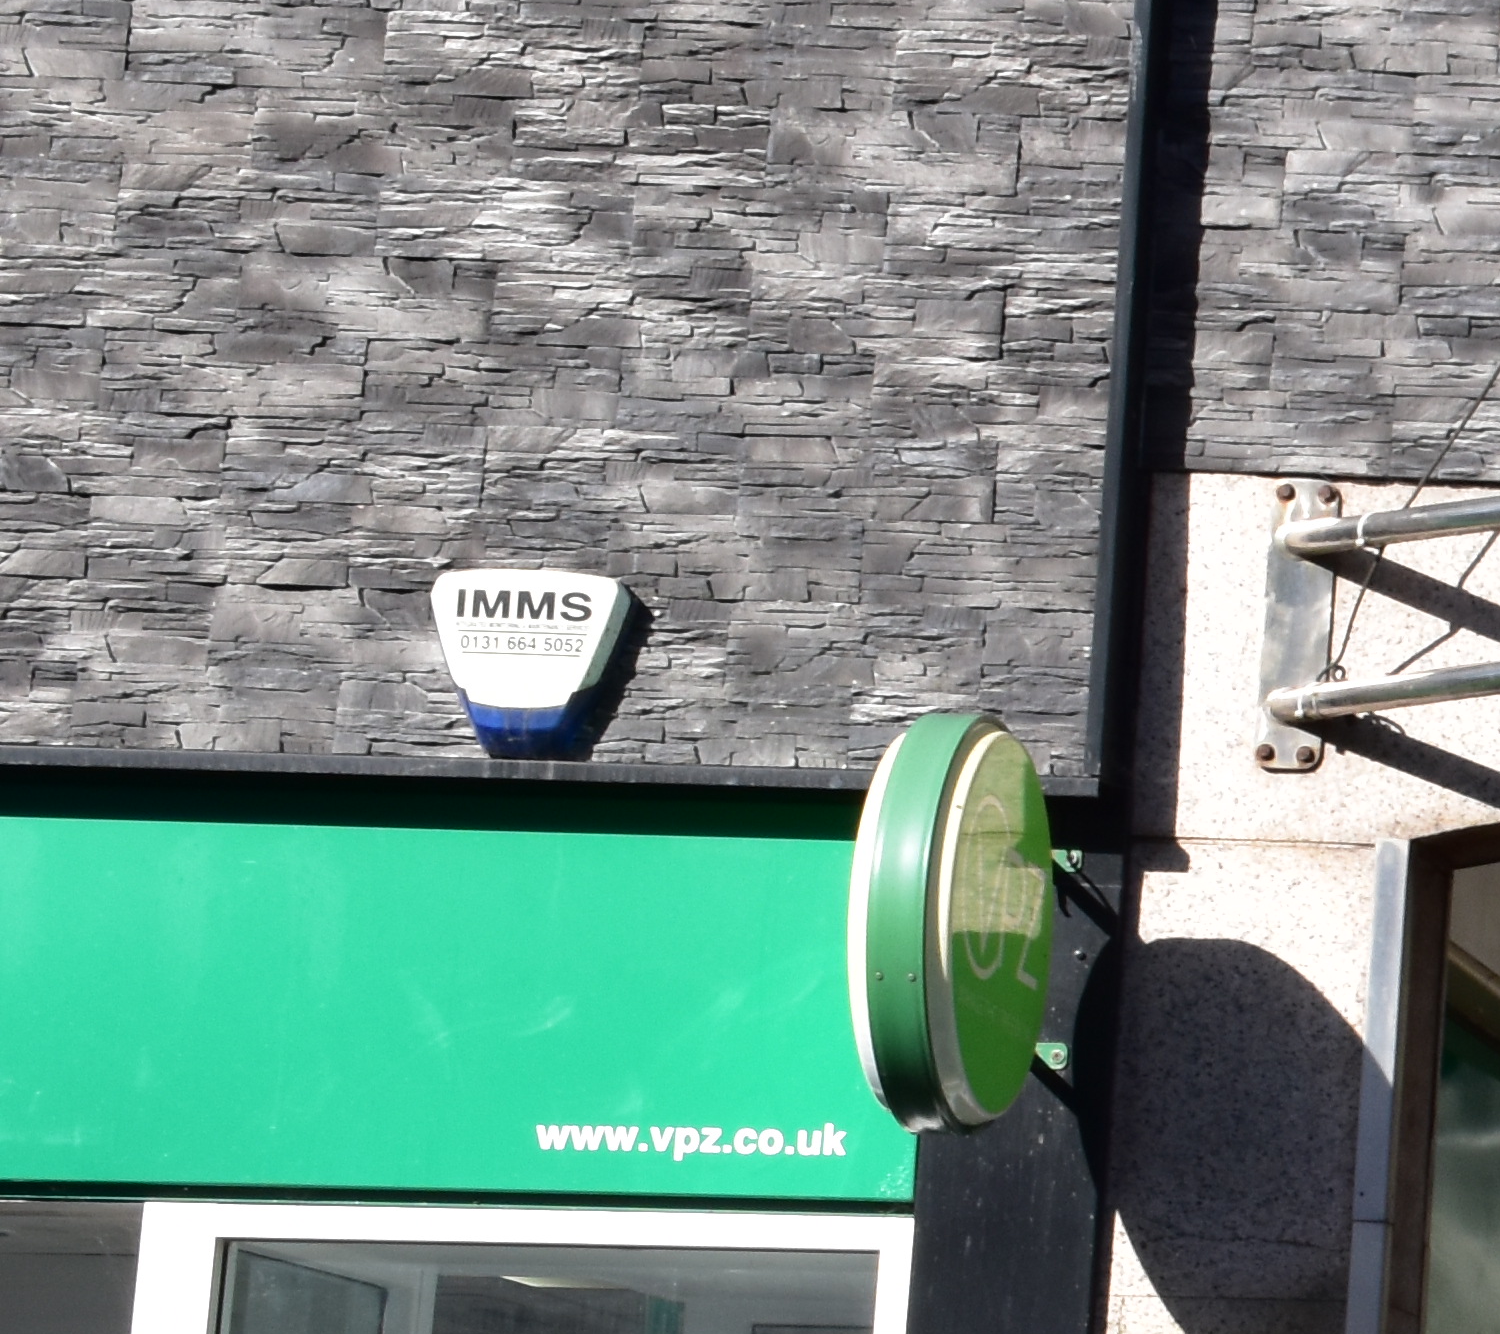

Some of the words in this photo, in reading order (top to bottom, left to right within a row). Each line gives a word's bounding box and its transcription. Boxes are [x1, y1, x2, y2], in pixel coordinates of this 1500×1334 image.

[456, 588, 593, 622] IMMS
[460, 634, 499, 649] 0131
[507, 636, 536, 651] 664
[543, 637, 584, 653] 5052
[535, 1121, 848, 1162] www.vpz.co.uk
